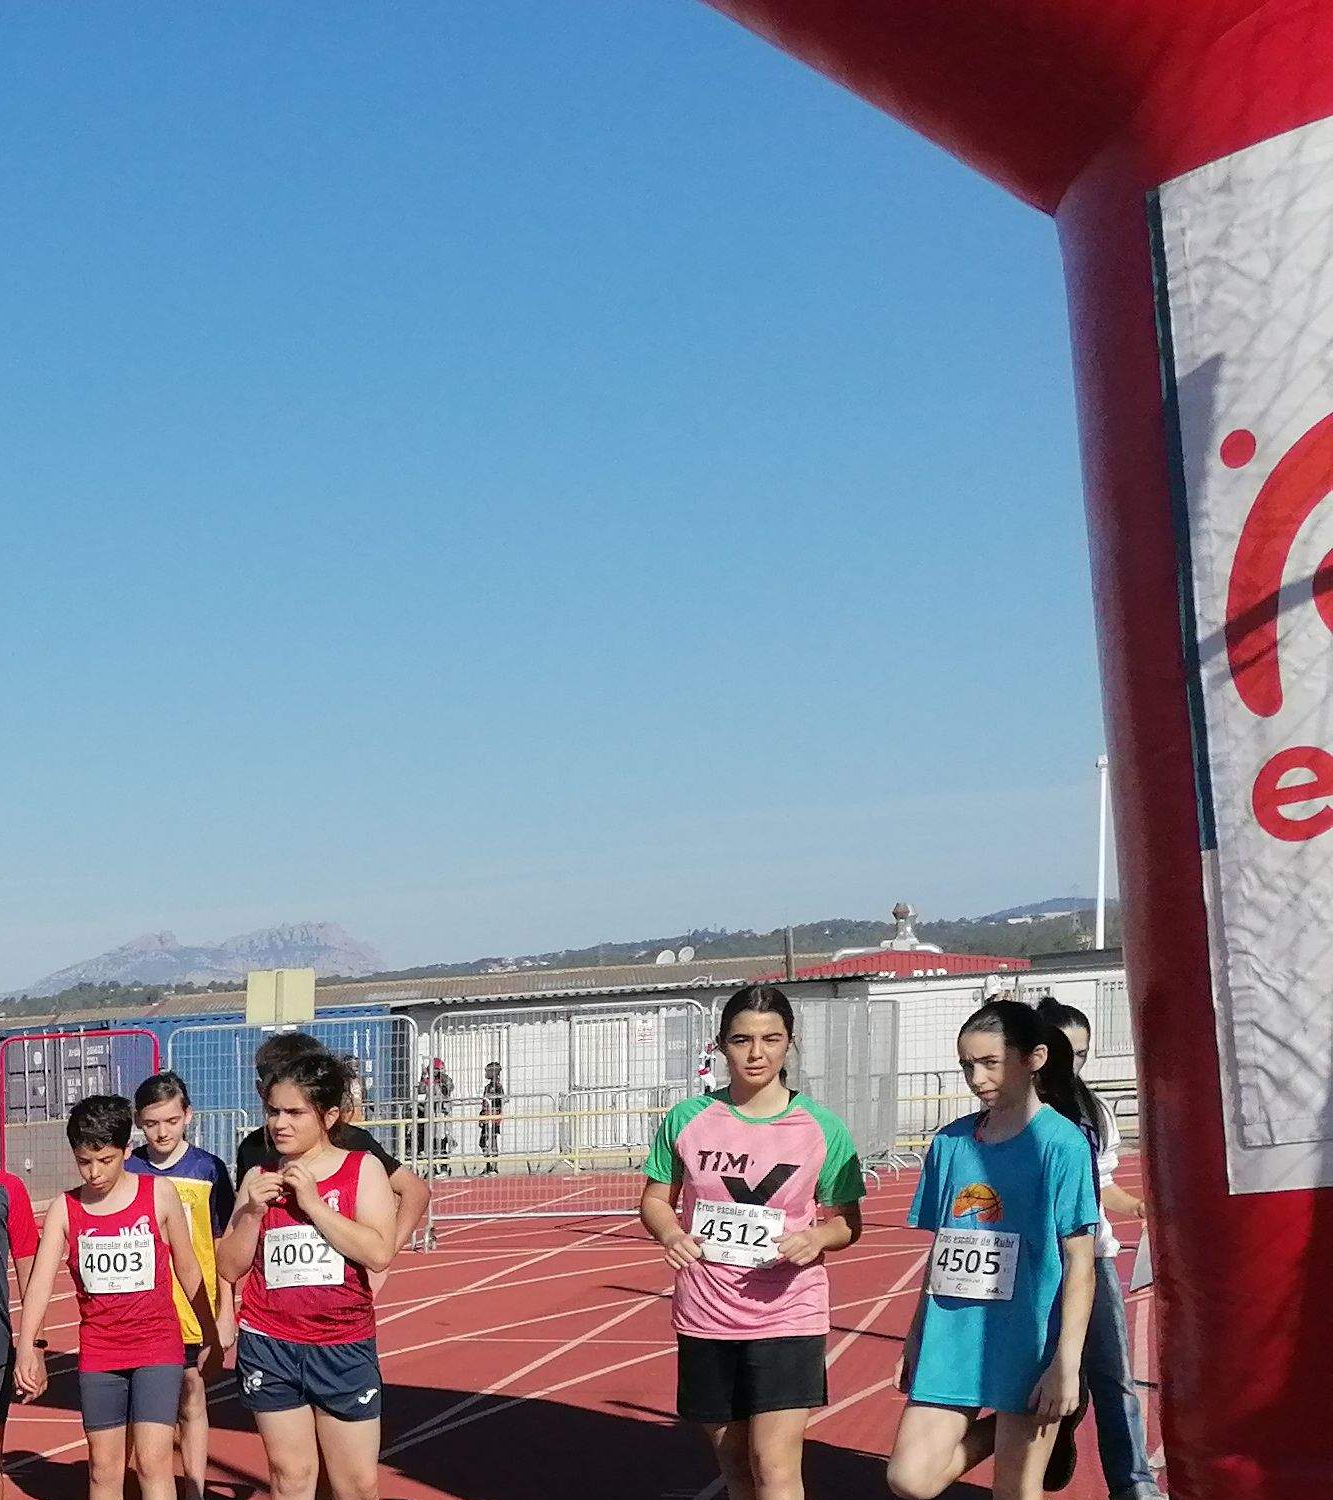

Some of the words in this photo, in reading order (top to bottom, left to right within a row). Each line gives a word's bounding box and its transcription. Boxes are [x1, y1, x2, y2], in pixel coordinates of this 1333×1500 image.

[698, 1150, 749, 1174] TIM
[700, 1219, 770, 1248] 4512
[85, 1252, 143, 1273] 4003
[270, 1243, 331, 1266] 4002
[937, 1248, 1001, 1275] 4505
